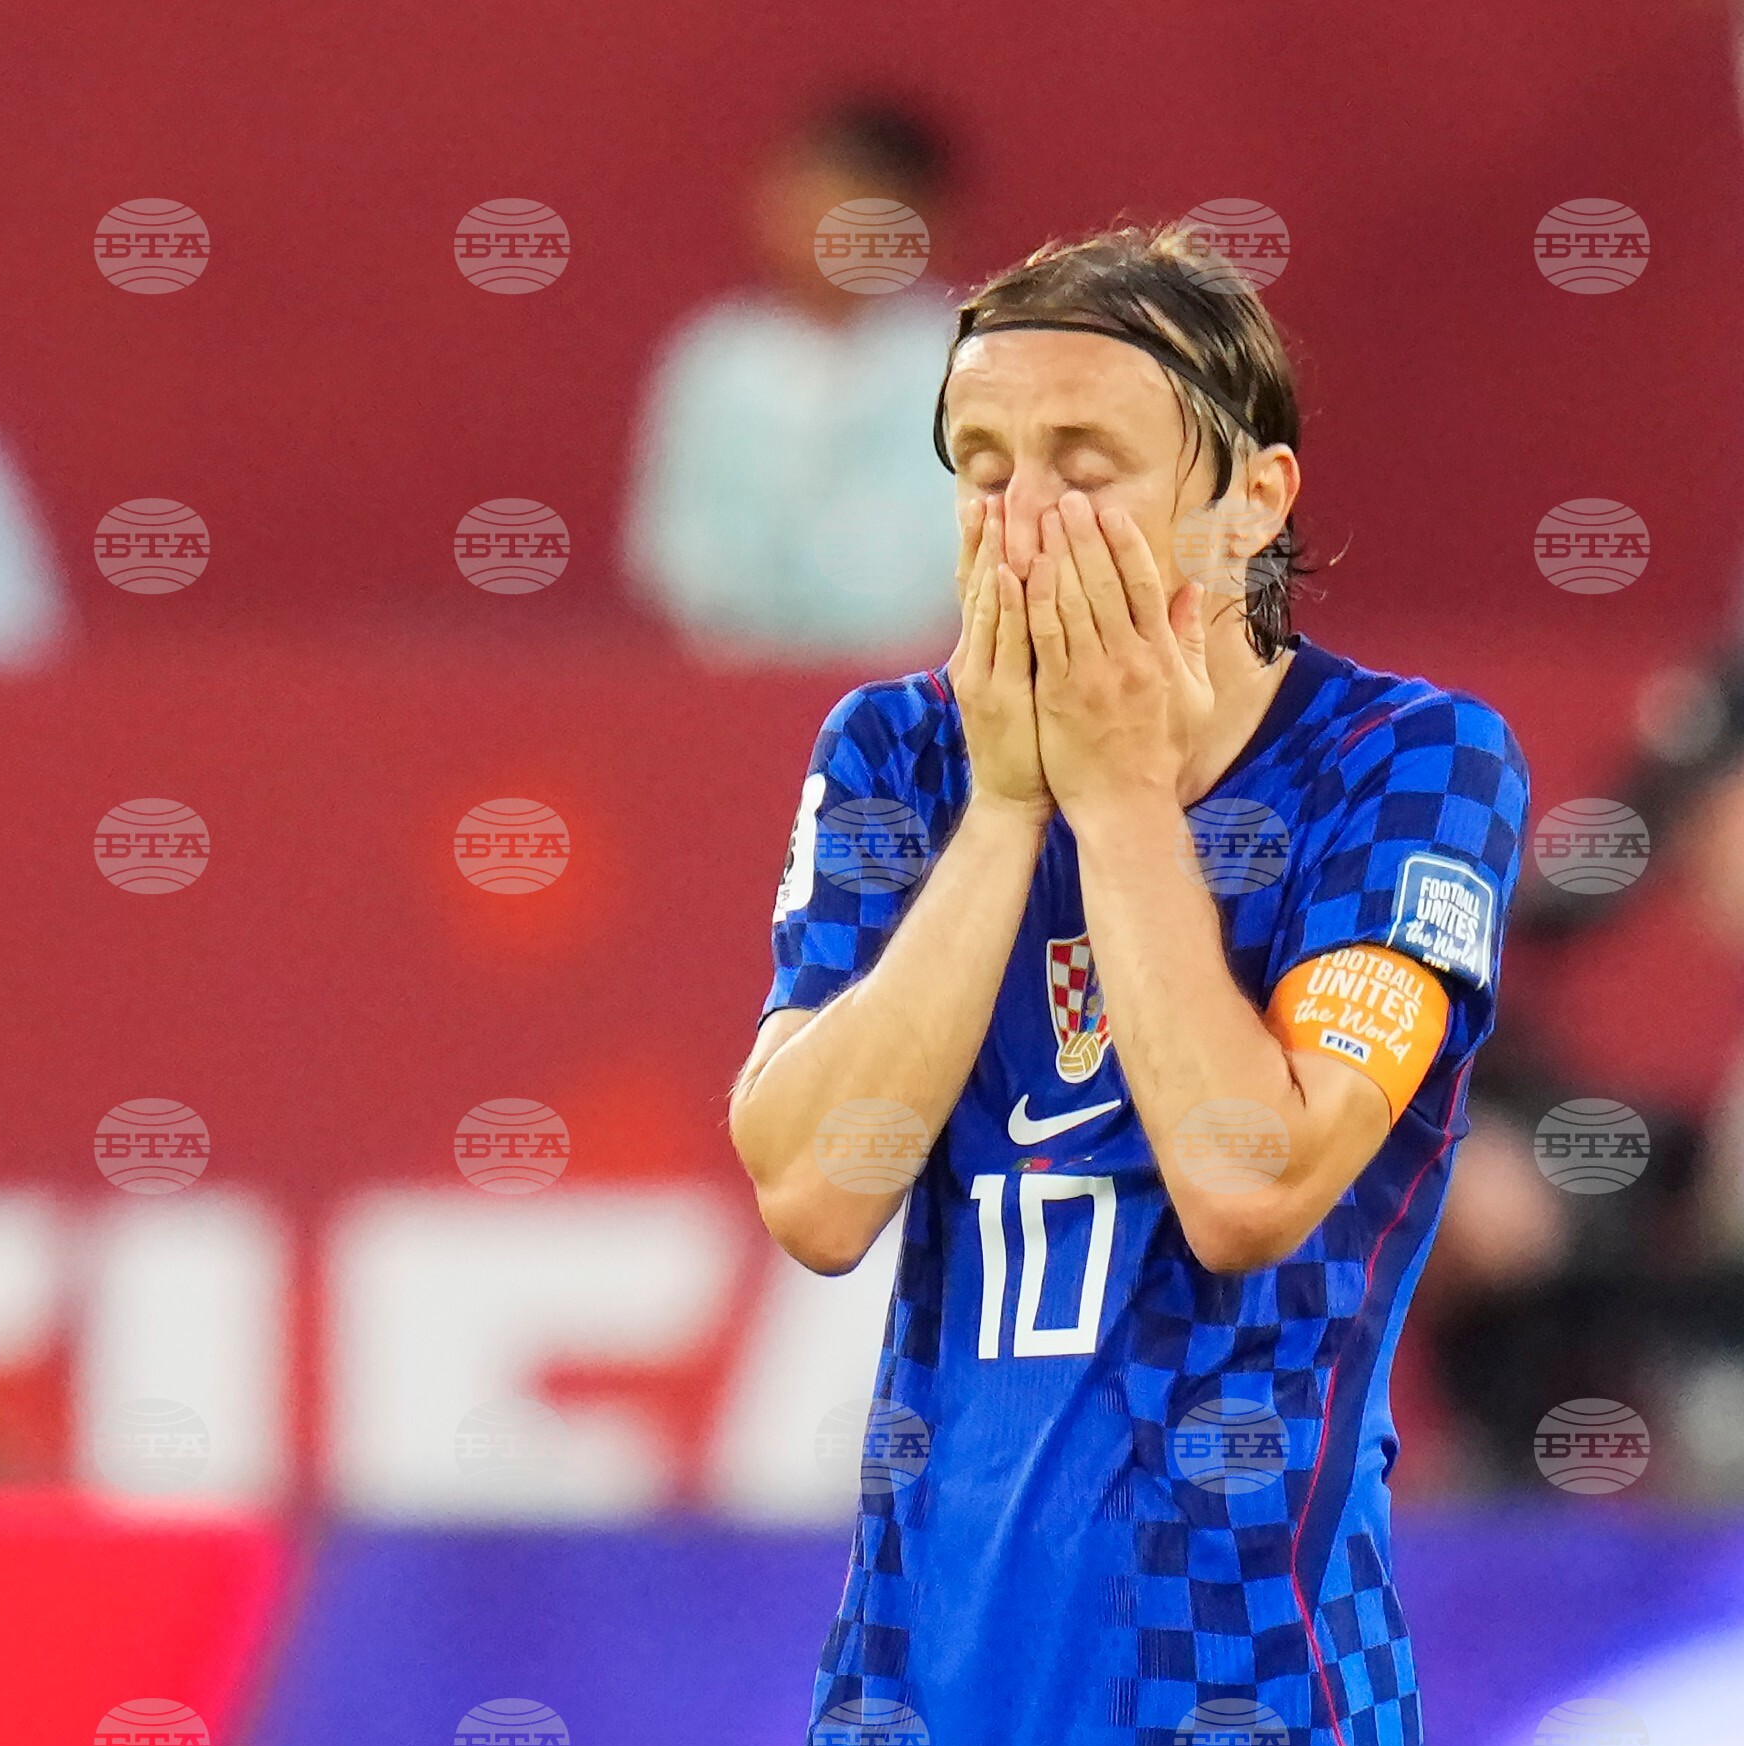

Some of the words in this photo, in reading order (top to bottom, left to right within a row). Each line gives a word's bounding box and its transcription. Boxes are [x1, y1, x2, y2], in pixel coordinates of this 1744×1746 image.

[1416, 897, 1479, 945] UNITES
[1420, 876, 1480, 919] FOOTBALL
[1405, 918, 1433, 948] the
[1433, 929, 1478, 973] World
[1306, 966, 1420, 1032] UNITES
[1317, 948, 1425, 1007] FOOTBALL
[1293, 996, 1334, 1025] the
[1338, 1001, 1413, 1065] World
[1324, 1034, 1365, 1060] FIFA
[969, 1173, 1116, 1360] 10
